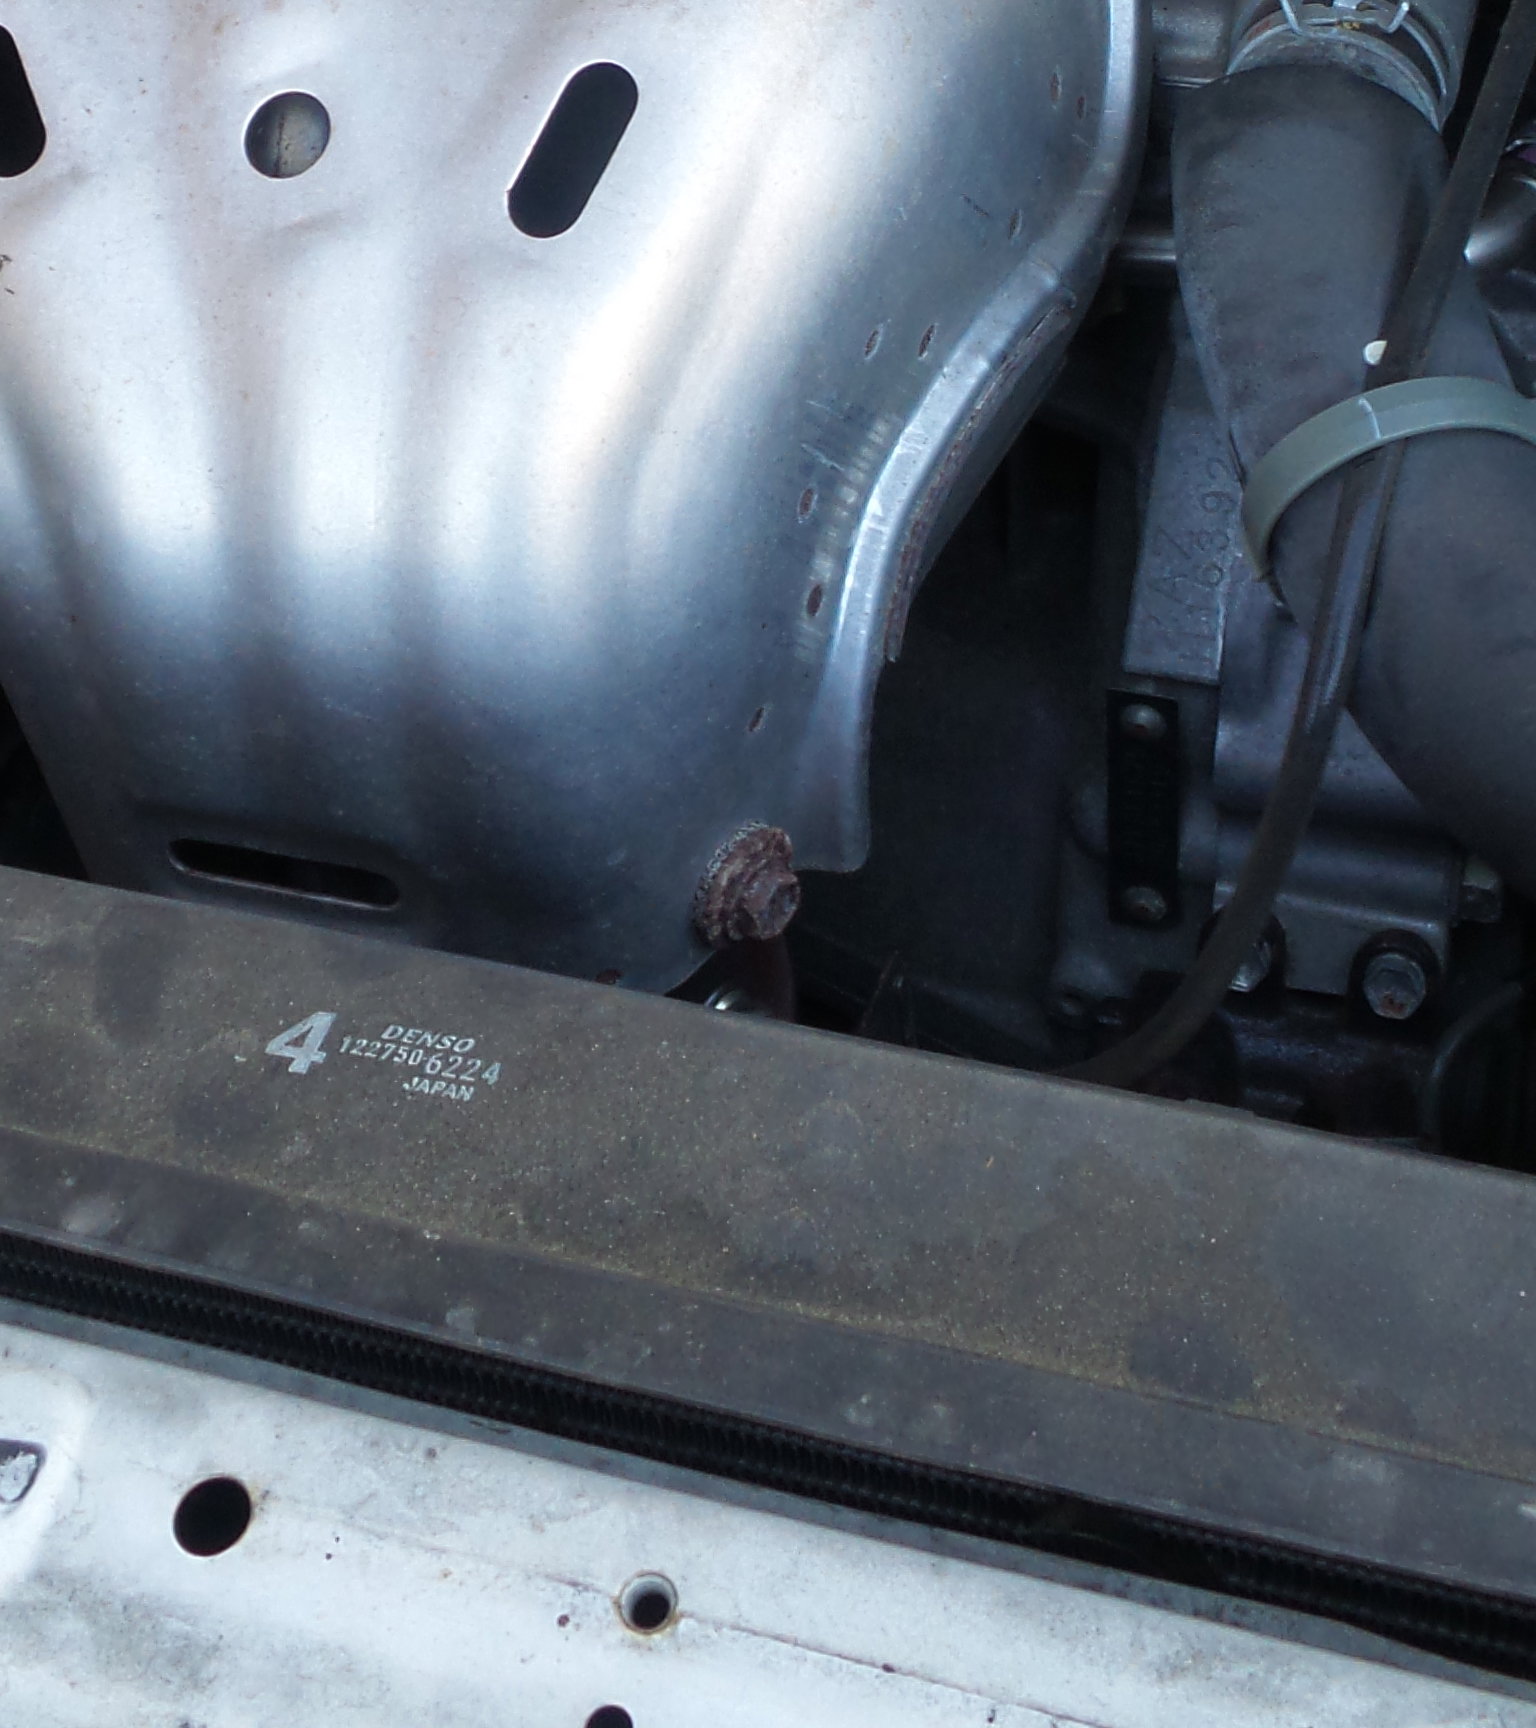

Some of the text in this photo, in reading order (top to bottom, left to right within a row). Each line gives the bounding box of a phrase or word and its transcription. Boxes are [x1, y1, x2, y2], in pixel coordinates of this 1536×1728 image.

[265, 1011, 337, 1074] 4
[381, 1024, 476, 1053] DENSO
[338, 1035, 502, 1085] 122750-6224
[402, 1076, 475, 1101] JAPAN
